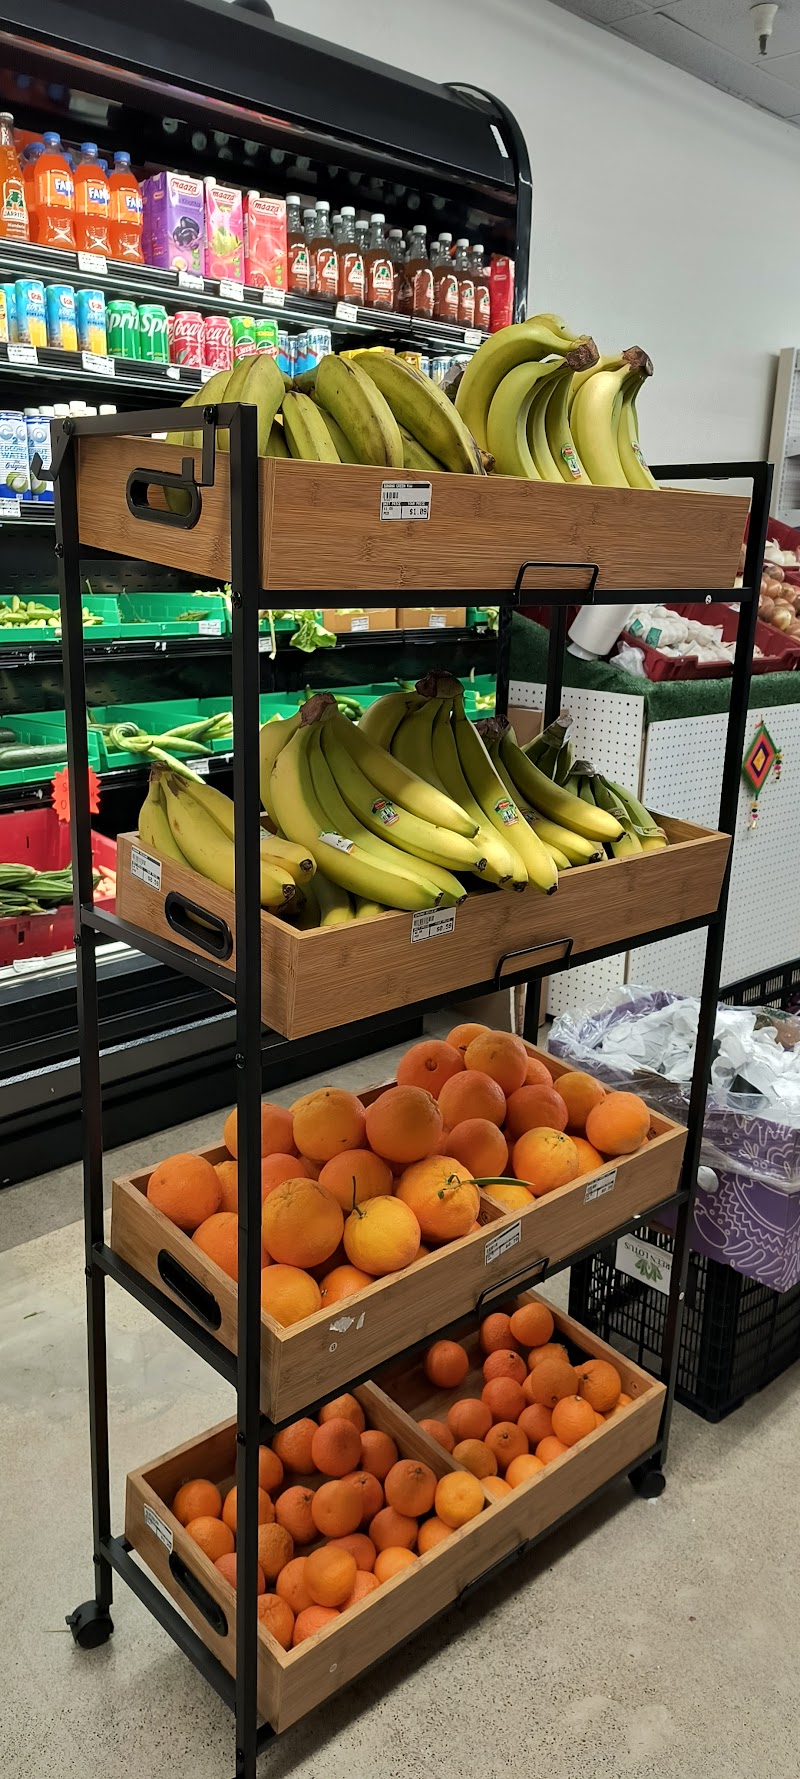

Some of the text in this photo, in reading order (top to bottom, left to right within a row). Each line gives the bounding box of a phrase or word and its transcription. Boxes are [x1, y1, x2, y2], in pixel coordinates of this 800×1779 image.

[172, 180, 197, 193] maaza
[212, 190, 235, 201] maaza
[254, 202, 280, 213] maaza
[624, 1241, 671, 1270] REEN LOTUS
